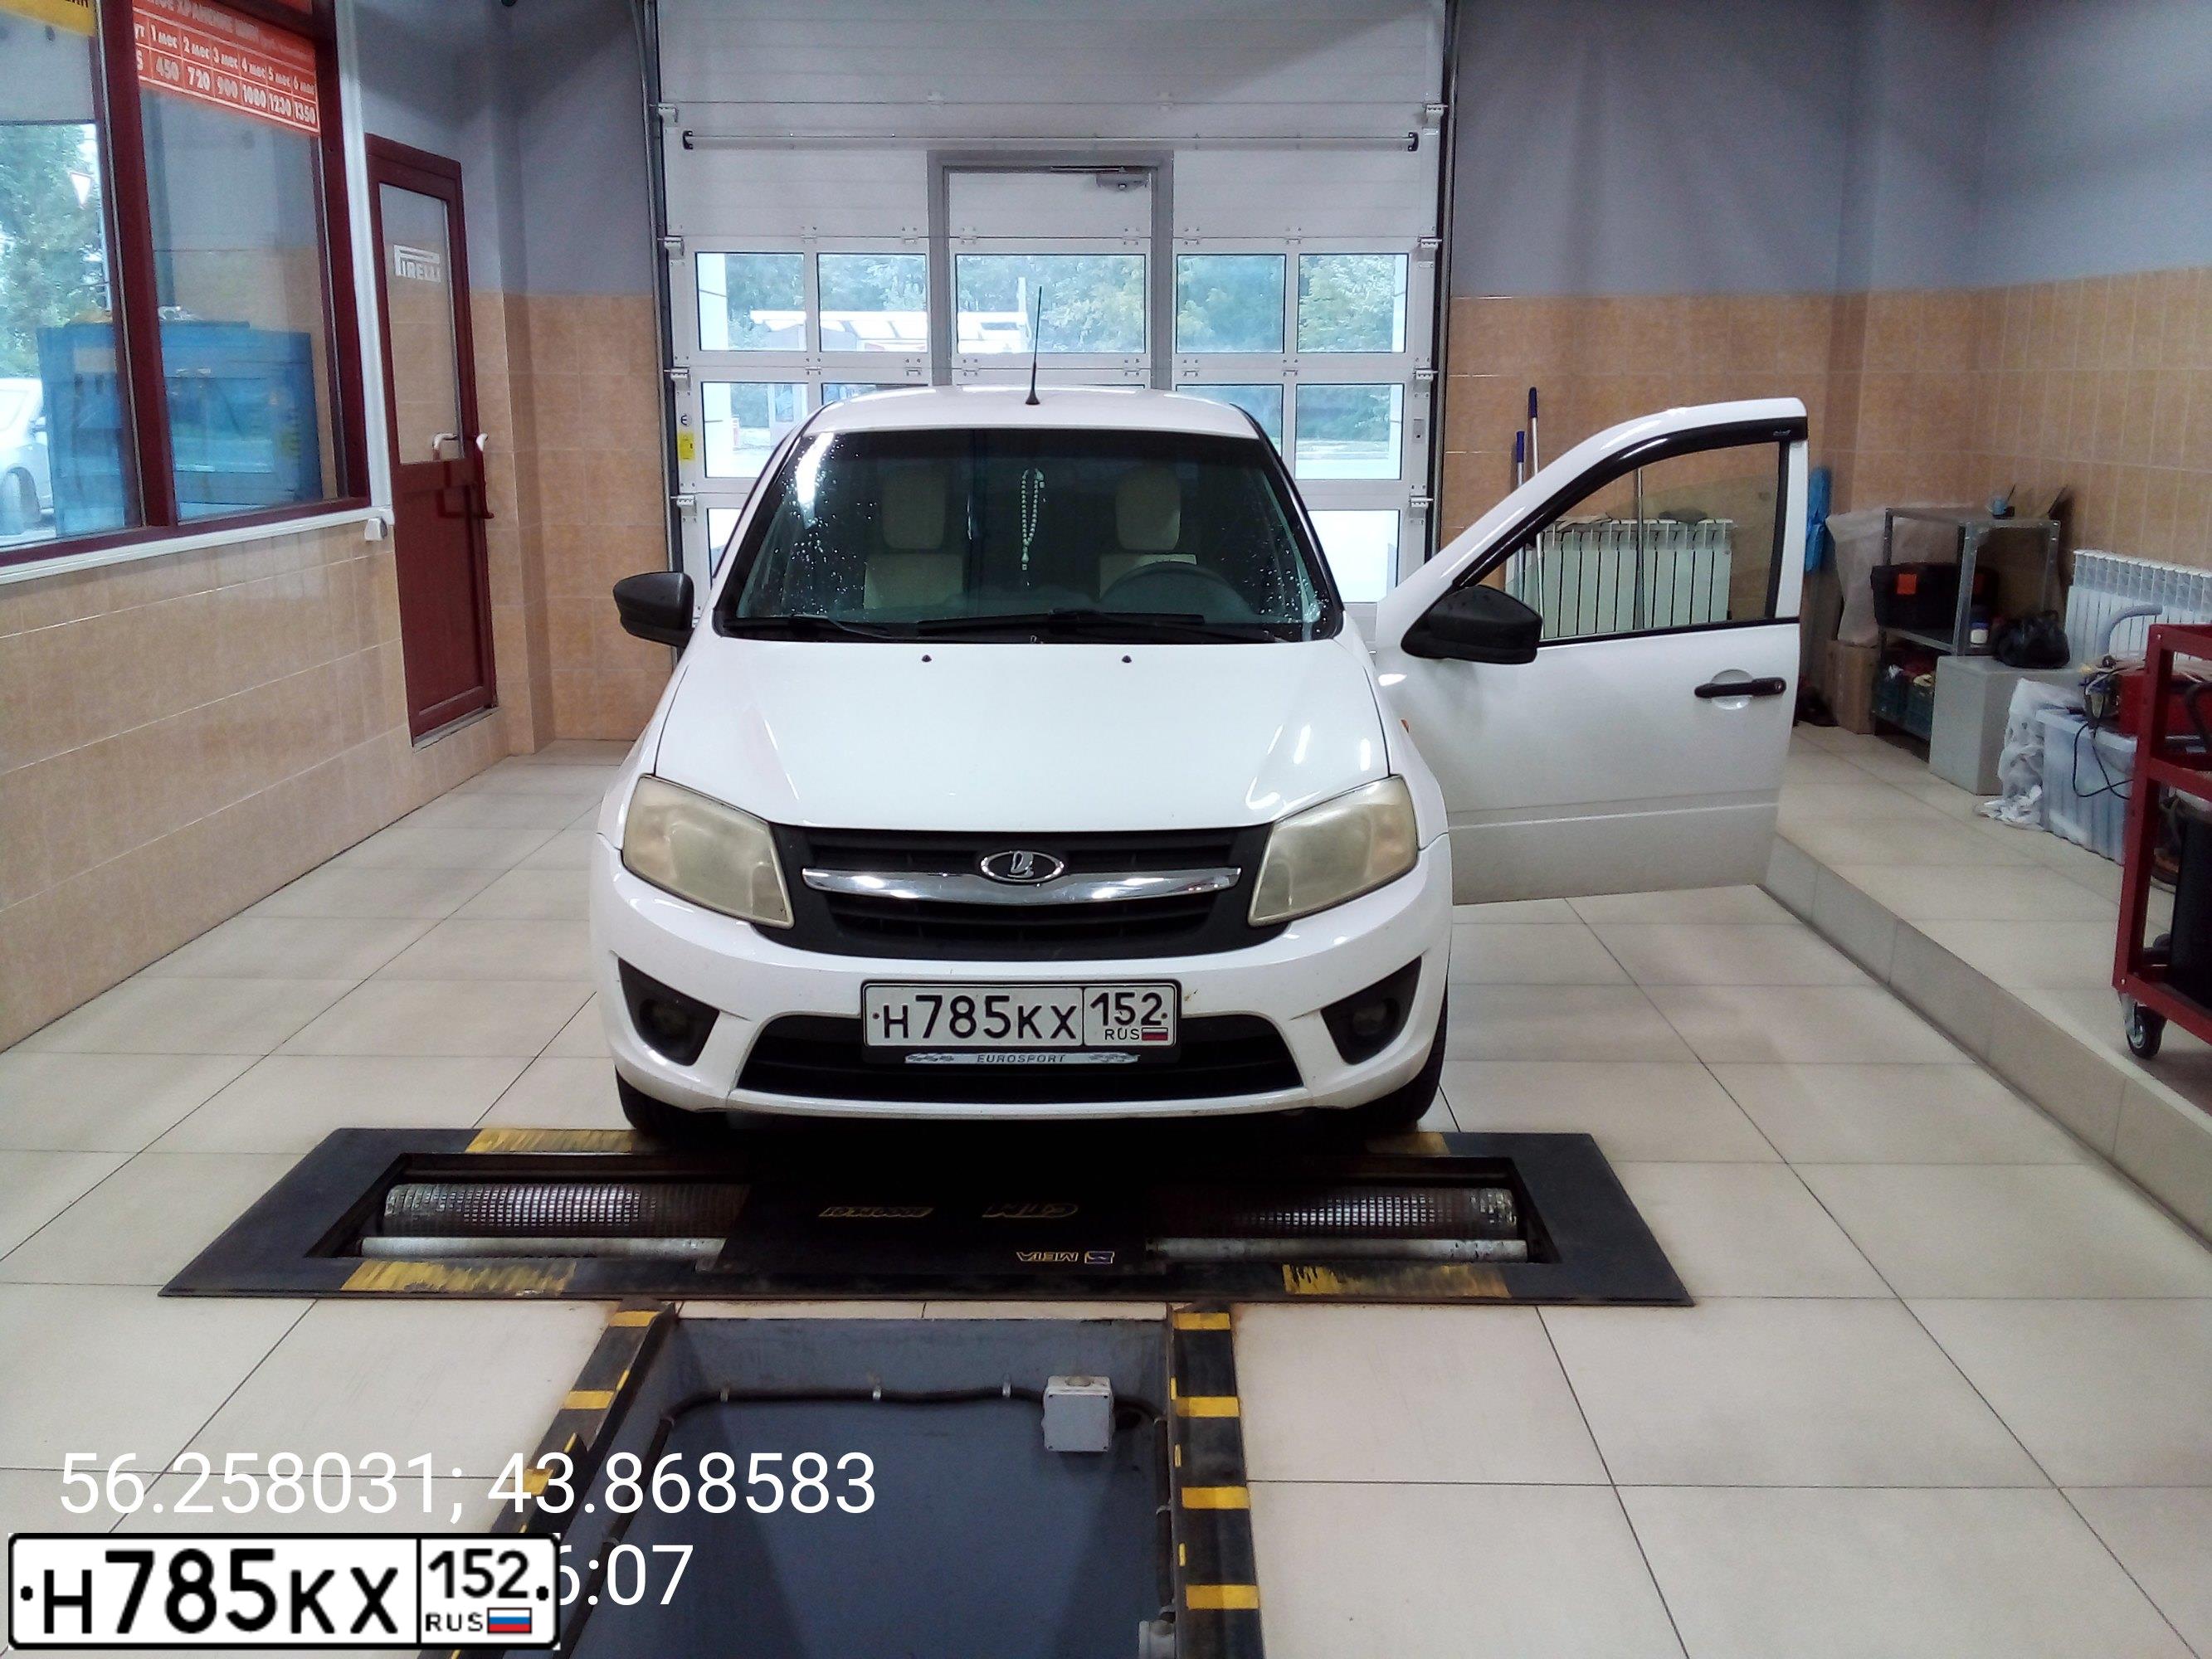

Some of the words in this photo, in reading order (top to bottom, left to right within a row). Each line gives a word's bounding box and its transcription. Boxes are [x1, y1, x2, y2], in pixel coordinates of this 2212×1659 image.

[150, 24, 157, 41] 1
[158, 32, 178, 49] мес
[183, 36, 190, 54] 2
[191, 43, 210, 61] мес
[212, 46, 220, 64] 3
[221, 54, 238, 70] мес
[241, 57, 248, 73] 4
[249, 63, 266, 80] мес
[268, 66, 274, 81] 5
[292, 75, 299, 90] 6
[155, 56, 179, 81] 450
[187, 66, 211, 91] 720
[217, 75, 238, 100] 900
[294, 100, 316, 126] 1350
[883, 995, 1078, 1039] Н785КХ
[1089, 992, 1163, 1027] 152
[1104, 1028, 1141, 1041] RUS
[976, 1053, 1068, 1063] EUROSPORT
